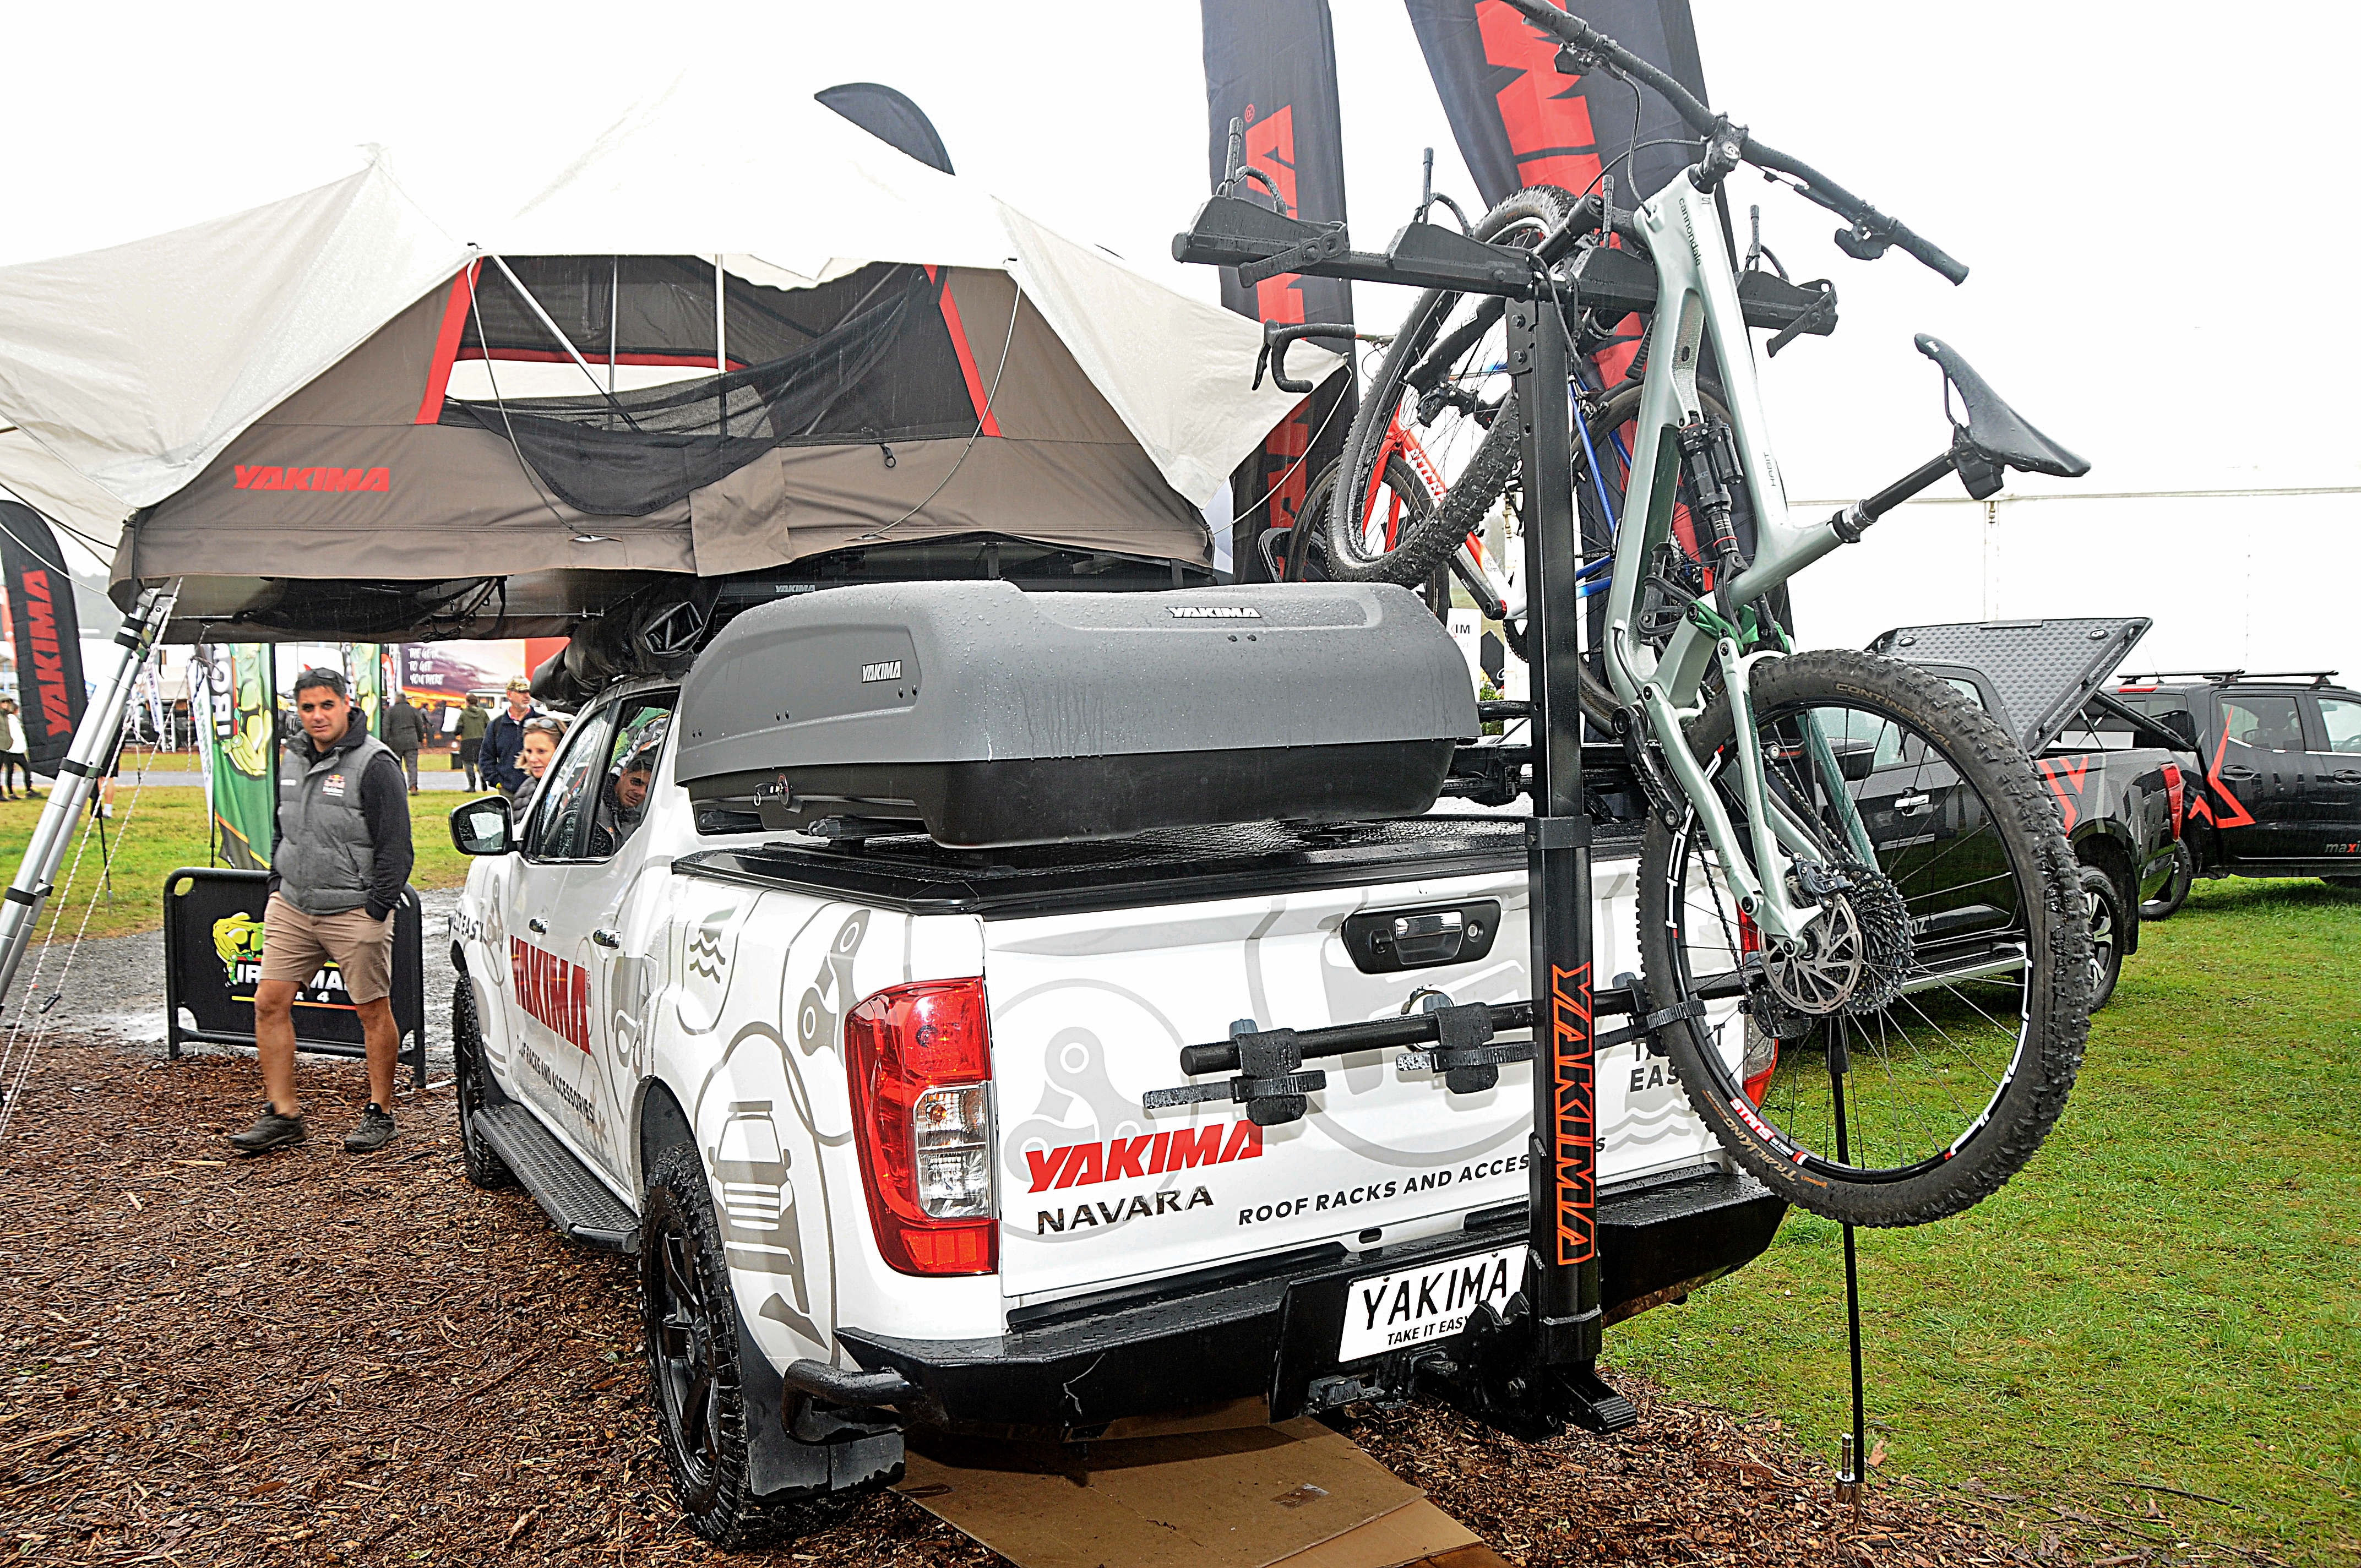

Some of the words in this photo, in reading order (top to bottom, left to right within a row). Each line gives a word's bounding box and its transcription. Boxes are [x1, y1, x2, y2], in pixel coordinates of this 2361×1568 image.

[1679, 198, 1701, 266] cannondale
[232, 465, 390, 492] YAKIMA
[1764, 452, 1776, 487] HABIT
[775, 585, 815, 593] YAKIMA
[1168, 607, 1260, 618] YAKIMA
[22, 570, 73, 737] YAKIMA
[408, 661, 417, 671] TO
[419, 661, 433, 672] GET
[862, 661, 901, 682] YAKIMA
[1836, 683, 1954, 753] CONTINENTAL
[2324, 840, 2361, 853] maxi
[510, 934, 591, 1057] YAKIMA
[1630, 1064, 1680, 1093] EAS
[1552, 961, 1596, 1266] YAKIMA
[1729, 1097, 1775, 1142] STANS
[1025, 1118, 1264, 1194] YAKIMA
[1037, 1184, 1214, 1235] NAVARA
[1238, 1198, 1308, 1226] ROOF
[1315, 1180, 1397, 1211] RACKS
[1403, 1168, 1452, 1195] AND
[1362, 1257, 1508, 1331] YAKIMA
[1387, 1326, 1420, 1346] TAKE
[1423, 1323, 1436, 1337] IT
